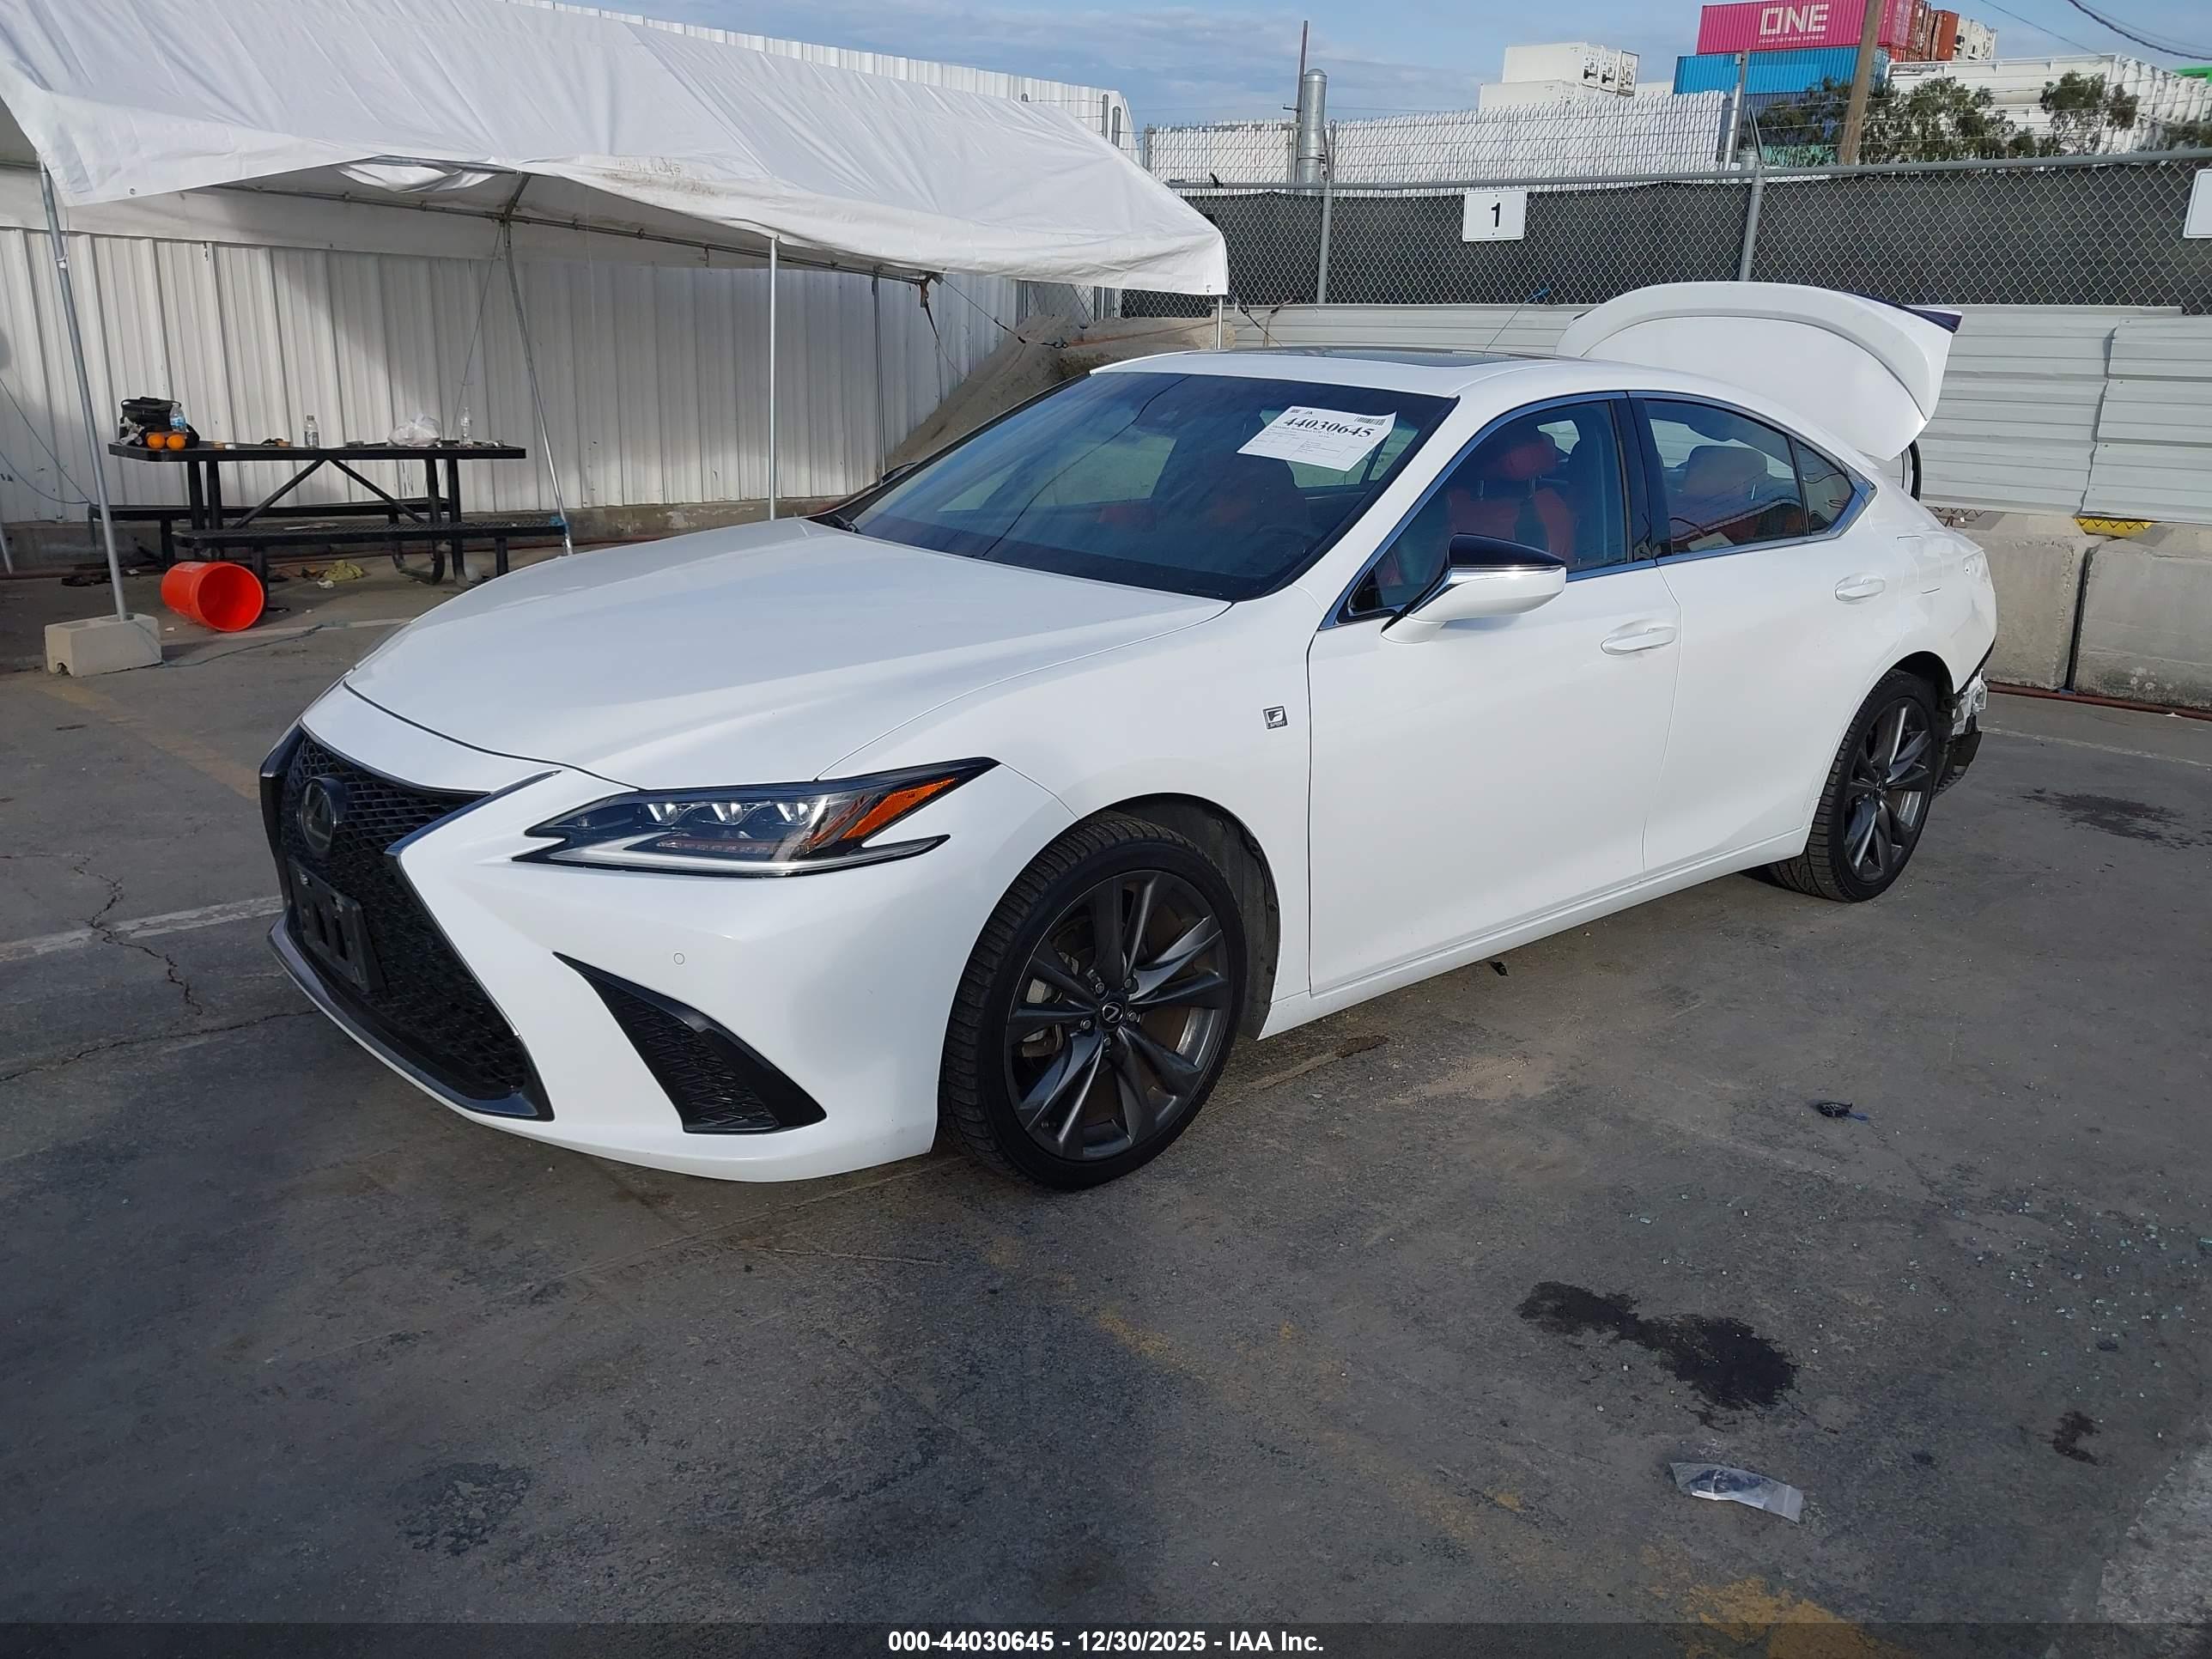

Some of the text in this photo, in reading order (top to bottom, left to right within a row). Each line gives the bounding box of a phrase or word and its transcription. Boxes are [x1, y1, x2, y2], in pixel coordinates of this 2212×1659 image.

[1759, 3, 1829, 35] ONE
[1491, 202, 1501, 228] 1
[1284, 417, 1375, 438] 44030645
